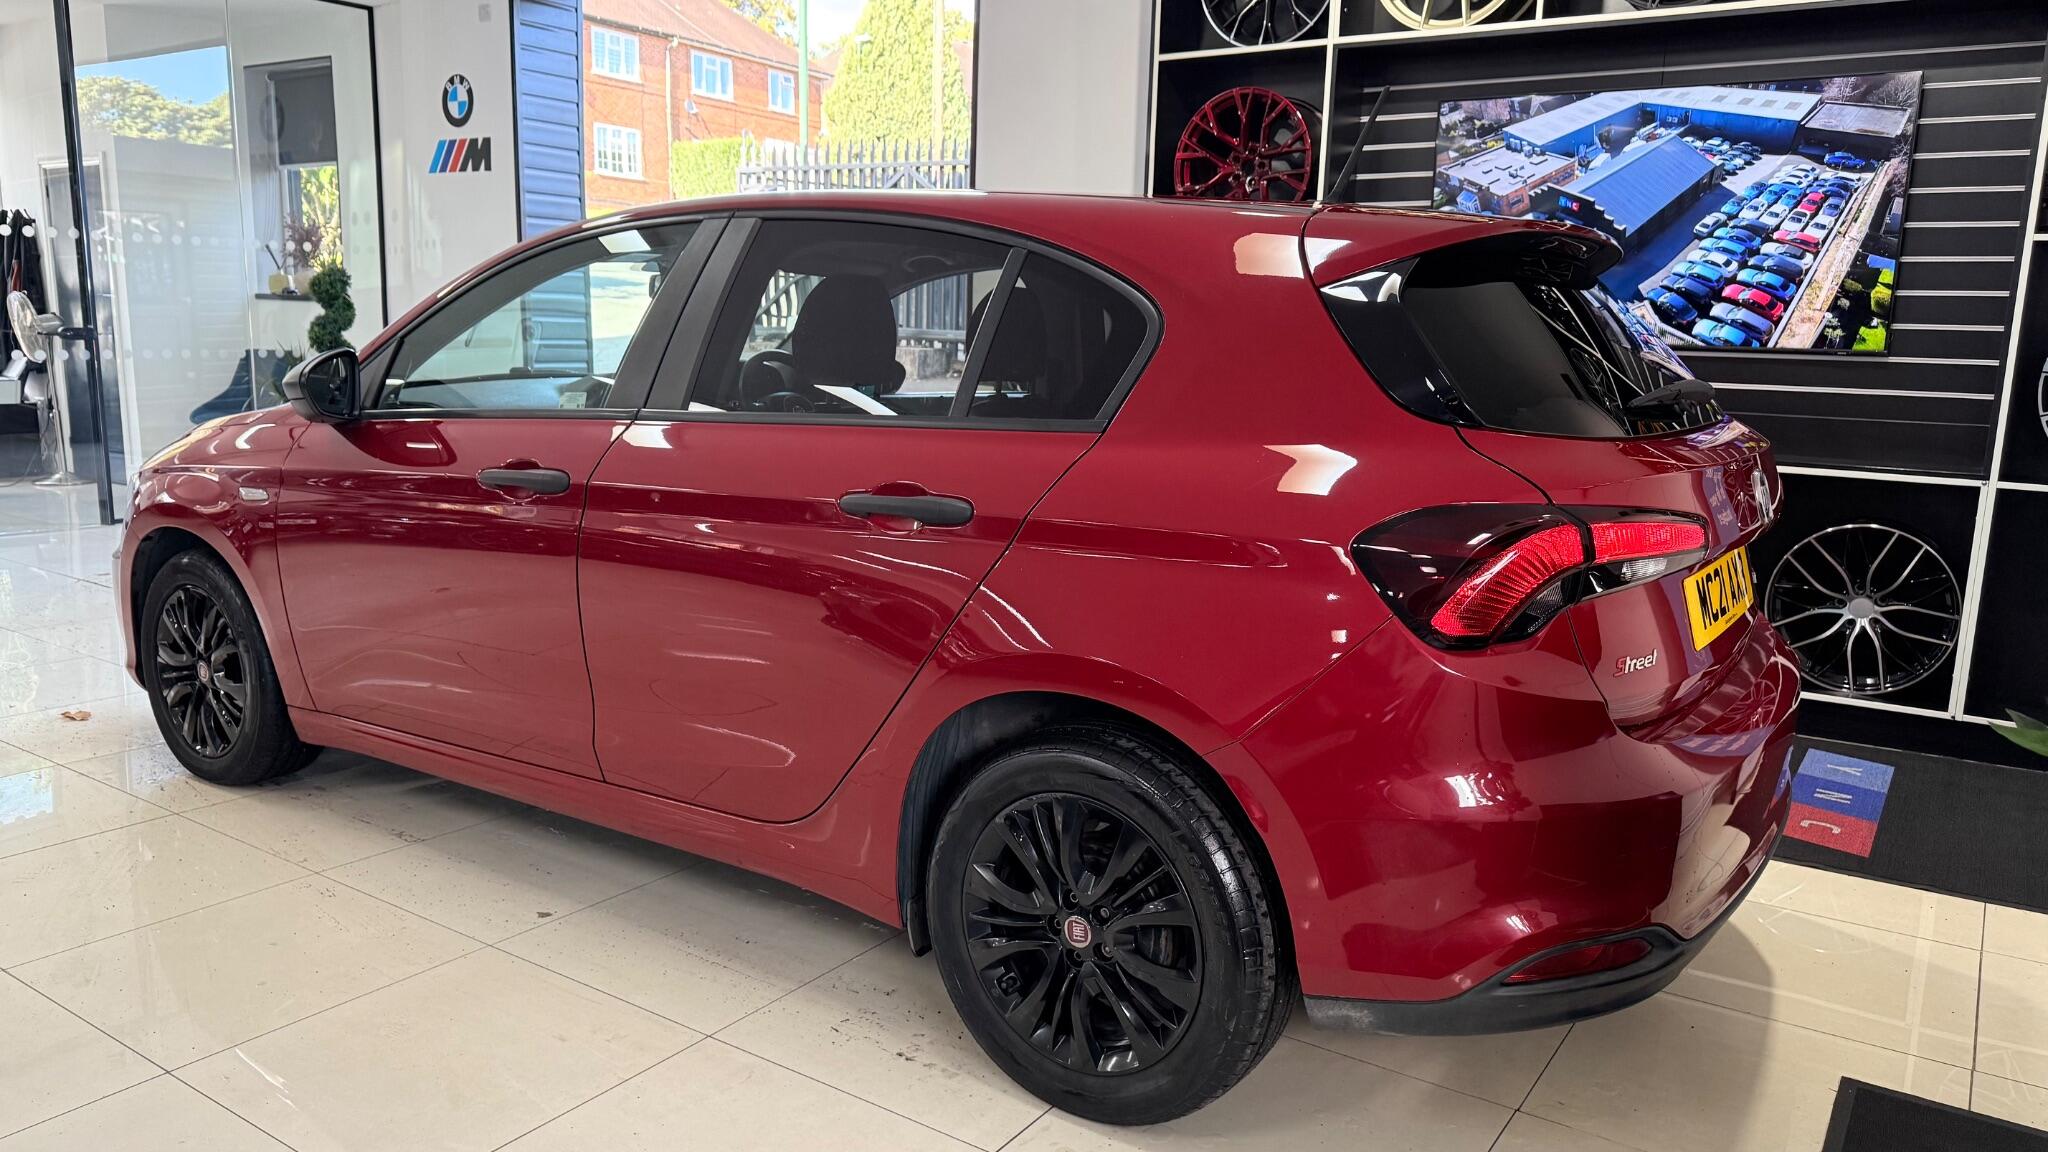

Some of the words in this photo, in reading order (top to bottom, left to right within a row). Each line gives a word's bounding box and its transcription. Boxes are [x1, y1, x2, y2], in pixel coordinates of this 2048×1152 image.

[1696, 564, 1730, 630] MC21
[1613, 648, 1657, 678] Street
[1072, 921, 1085, 941] FIAT
